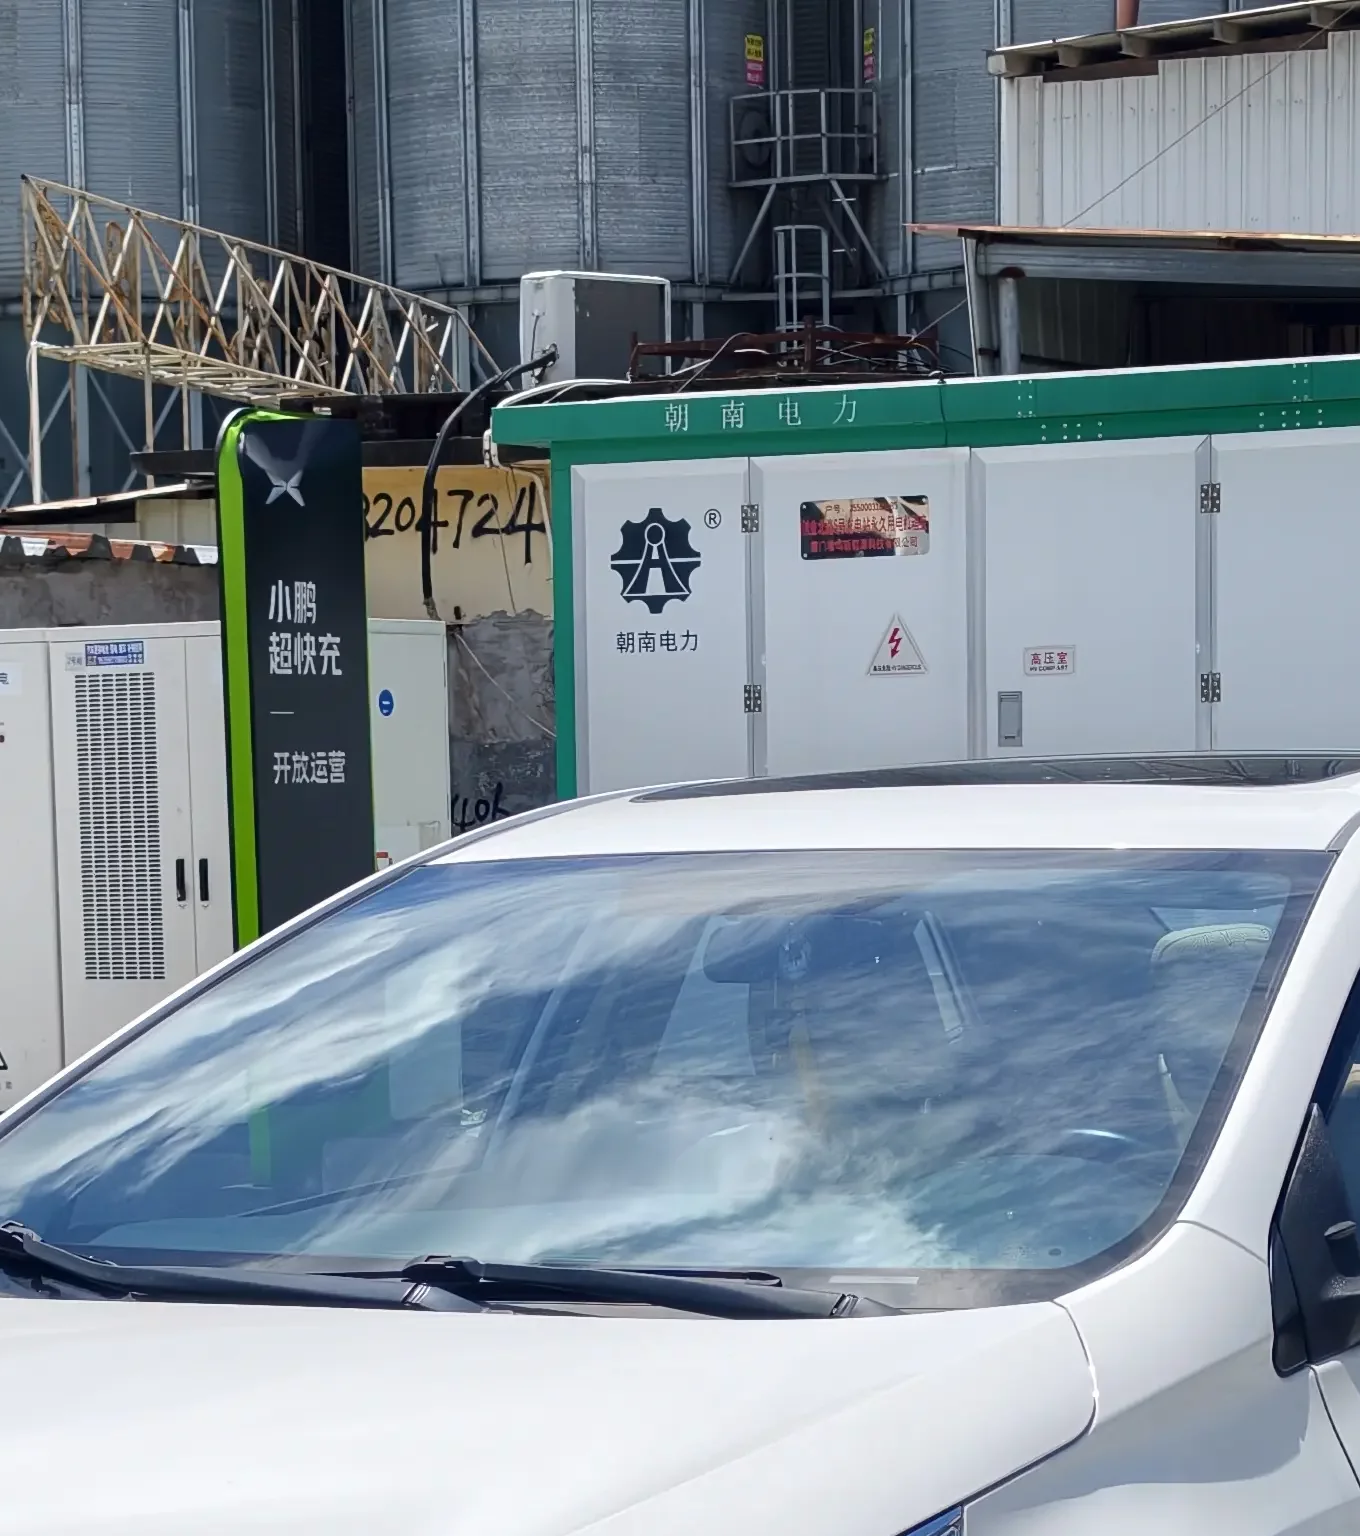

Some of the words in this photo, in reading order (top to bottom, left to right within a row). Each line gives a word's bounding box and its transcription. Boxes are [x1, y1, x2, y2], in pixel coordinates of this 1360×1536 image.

[664, 394, 857, 432] 朝南电力
[268, 580, 317, 624] 小鹏
[268, 632, 343, 675] 超快充
[616, 629, 699, 653] 朝南电力
[1030, 651, 1068, 665] 高压室
[273, 750, 346, 784] 开放运营
